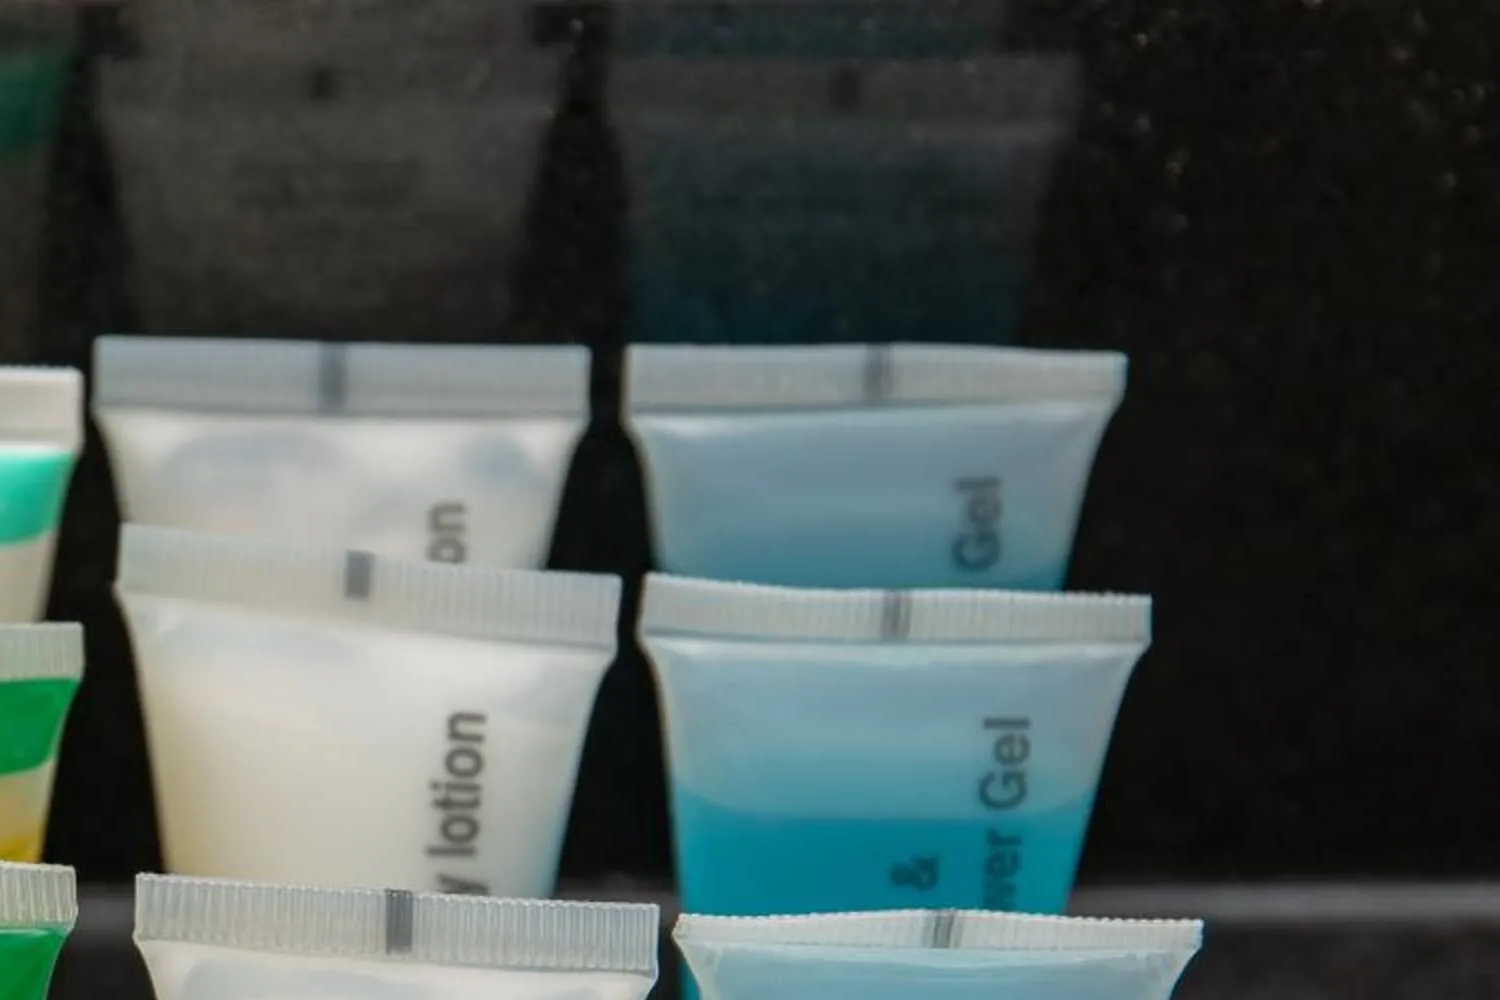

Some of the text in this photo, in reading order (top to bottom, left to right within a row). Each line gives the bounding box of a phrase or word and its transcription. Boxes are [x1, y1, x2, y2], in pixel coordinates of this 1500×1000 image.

[951, 475, 1002, 572] Gel
[426, 711, 487, 857] lotion
[979, 716, 1032, 810] Gel
